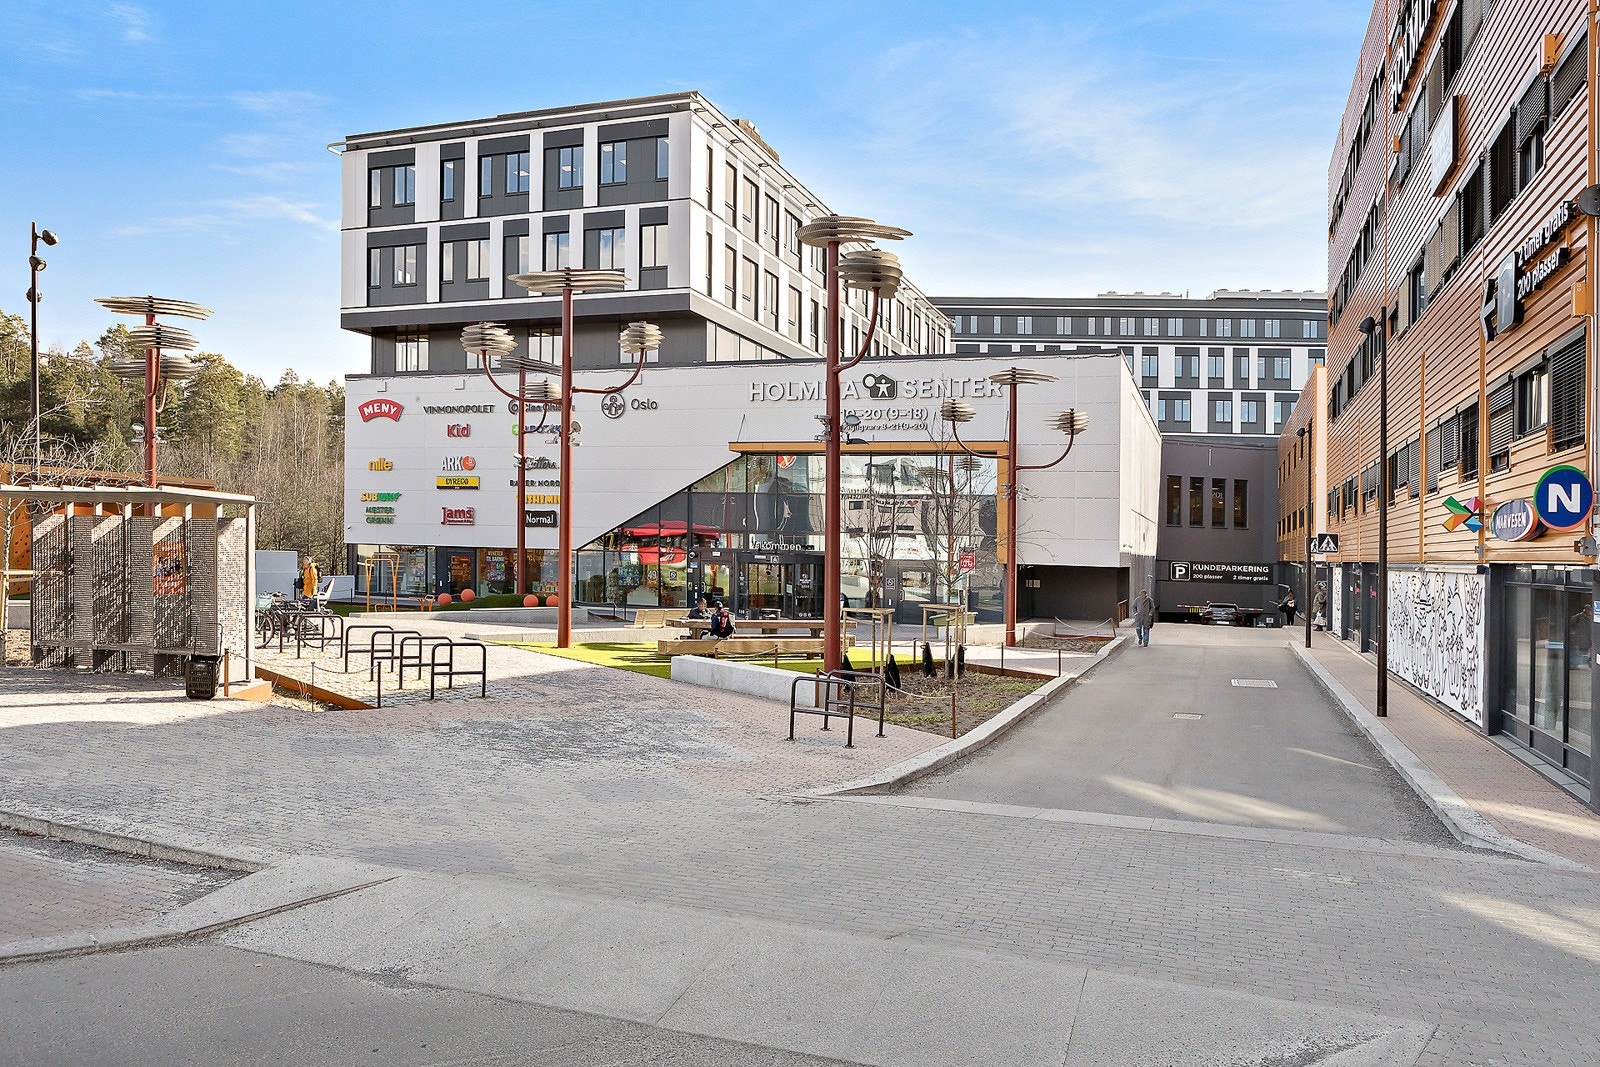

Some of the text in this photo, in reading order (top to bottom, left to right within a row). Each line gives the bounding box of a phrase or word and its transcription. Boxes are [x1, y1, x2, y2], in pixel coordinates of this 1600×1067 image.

[1518, 202, 1569, 268] 2 timer gratis
[1517, 249, 1561, 300] 200 plasser
[904, 378, 1003, 398] SENTER
[363, 403, 398, 416] MENY
[423, 405, 495, 414] VINMONOPOLET
[630, 398, 658, 411] Oslo
[447, 423, 470, 437] Kid
[367, 457, 393, 471] nille
[442, 456, 463, 471] ARK
[360, 492, 402, 502] SUBWAY
[1548, 483, 1580, 513] N
[365, 507, 395, 515] MESTER
[441, 506, 474, 526] Jams
[526, 513, 554, 524] Normal
[1496, 511, 1527, 530] NARVESEN
[1192, 564, 1269, 573] KUNDEPARKERING
